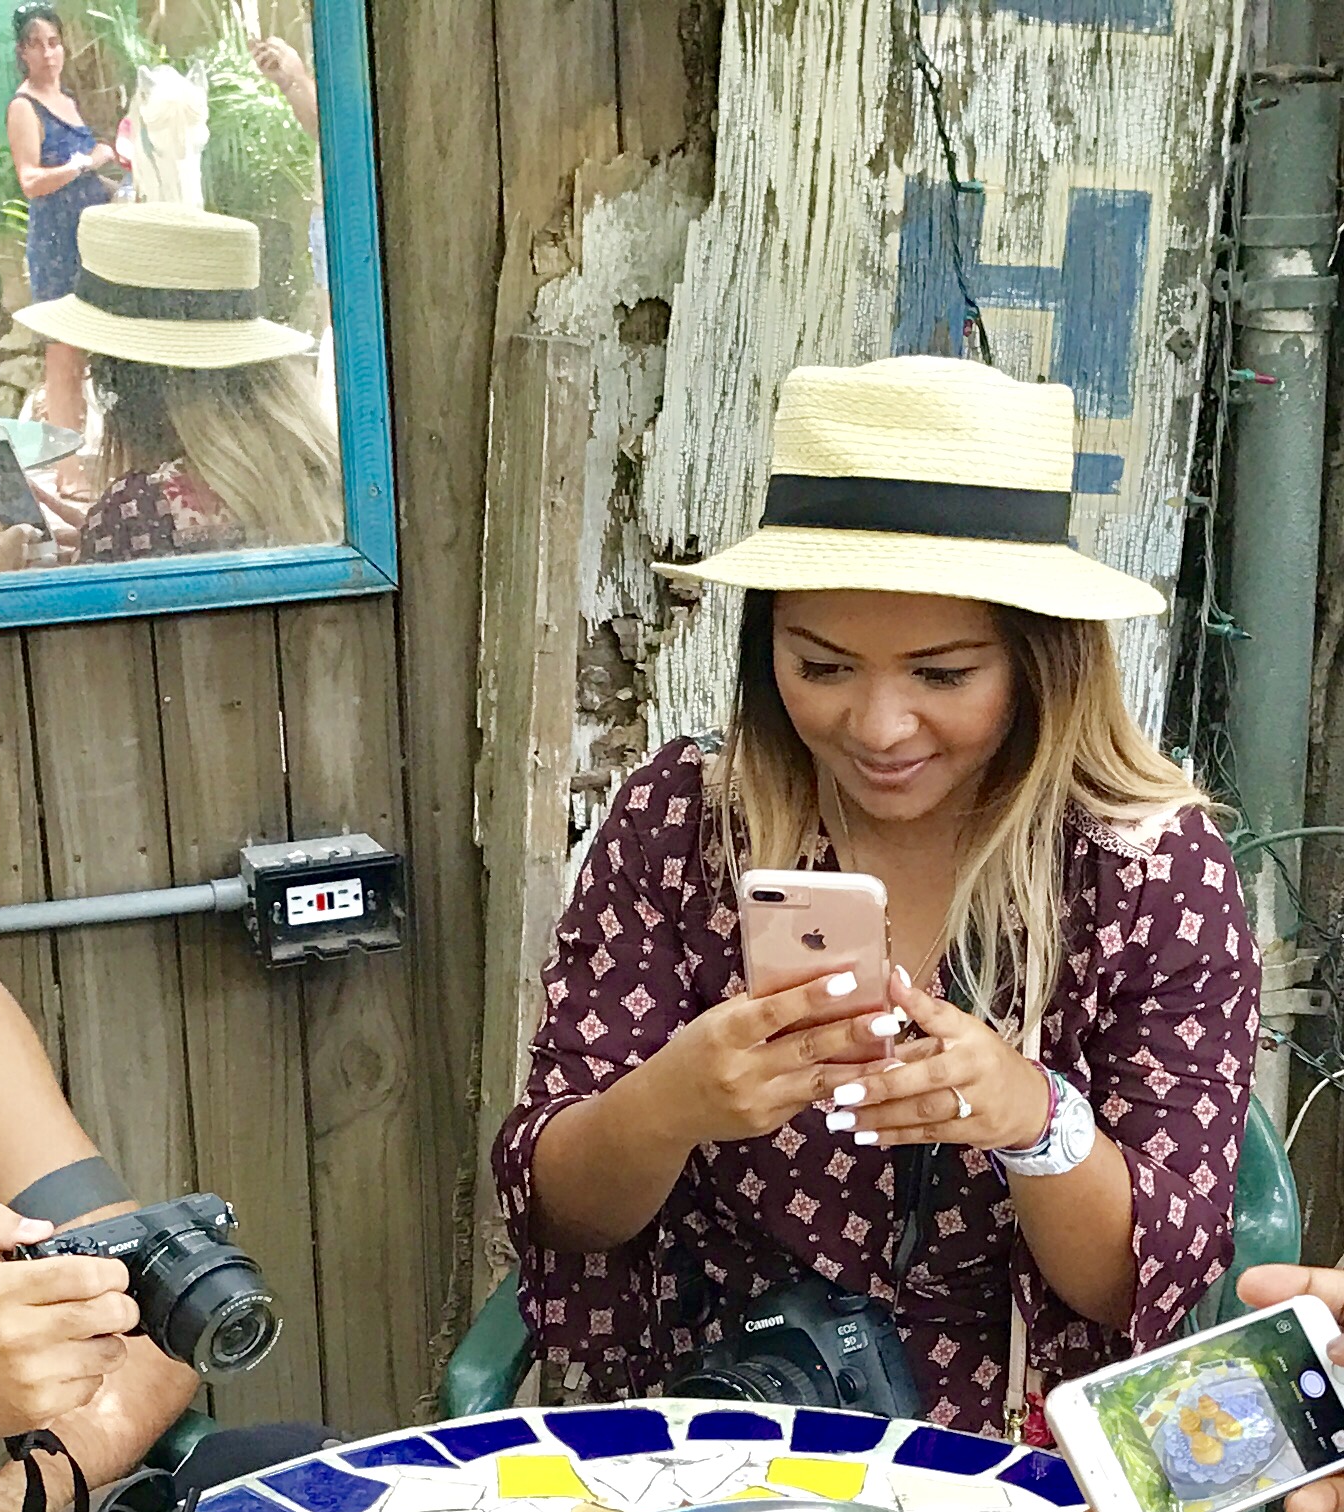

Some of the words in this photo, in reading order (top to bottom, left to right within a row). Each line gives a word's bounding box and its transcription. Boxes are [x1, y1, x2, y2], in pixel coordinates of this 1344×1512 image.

[108, 1239, 139, 1255] SONY
[745, 1314, 785, 1333] Canon
[837, 1322, 858, 1336] EOS
